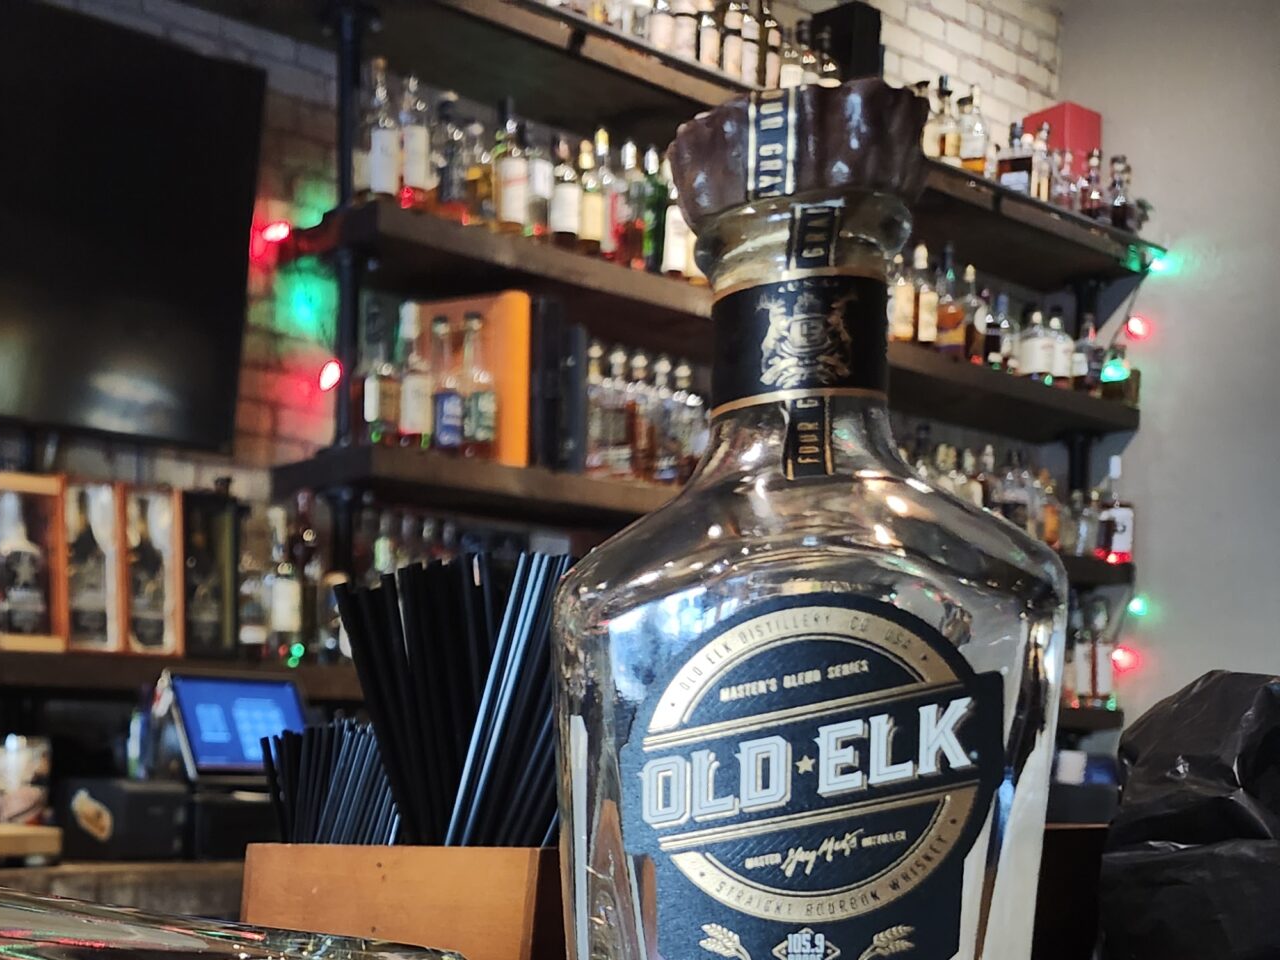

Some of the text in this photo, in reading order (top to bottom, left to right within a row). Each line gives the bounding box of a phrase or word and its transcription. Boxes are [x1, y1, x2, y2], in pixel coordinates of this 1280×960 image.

[826, 658, 870, 680] SERIES
[640, 695, 976, 829] OLD ELK
[787, 932, 825, 954] 105.9
